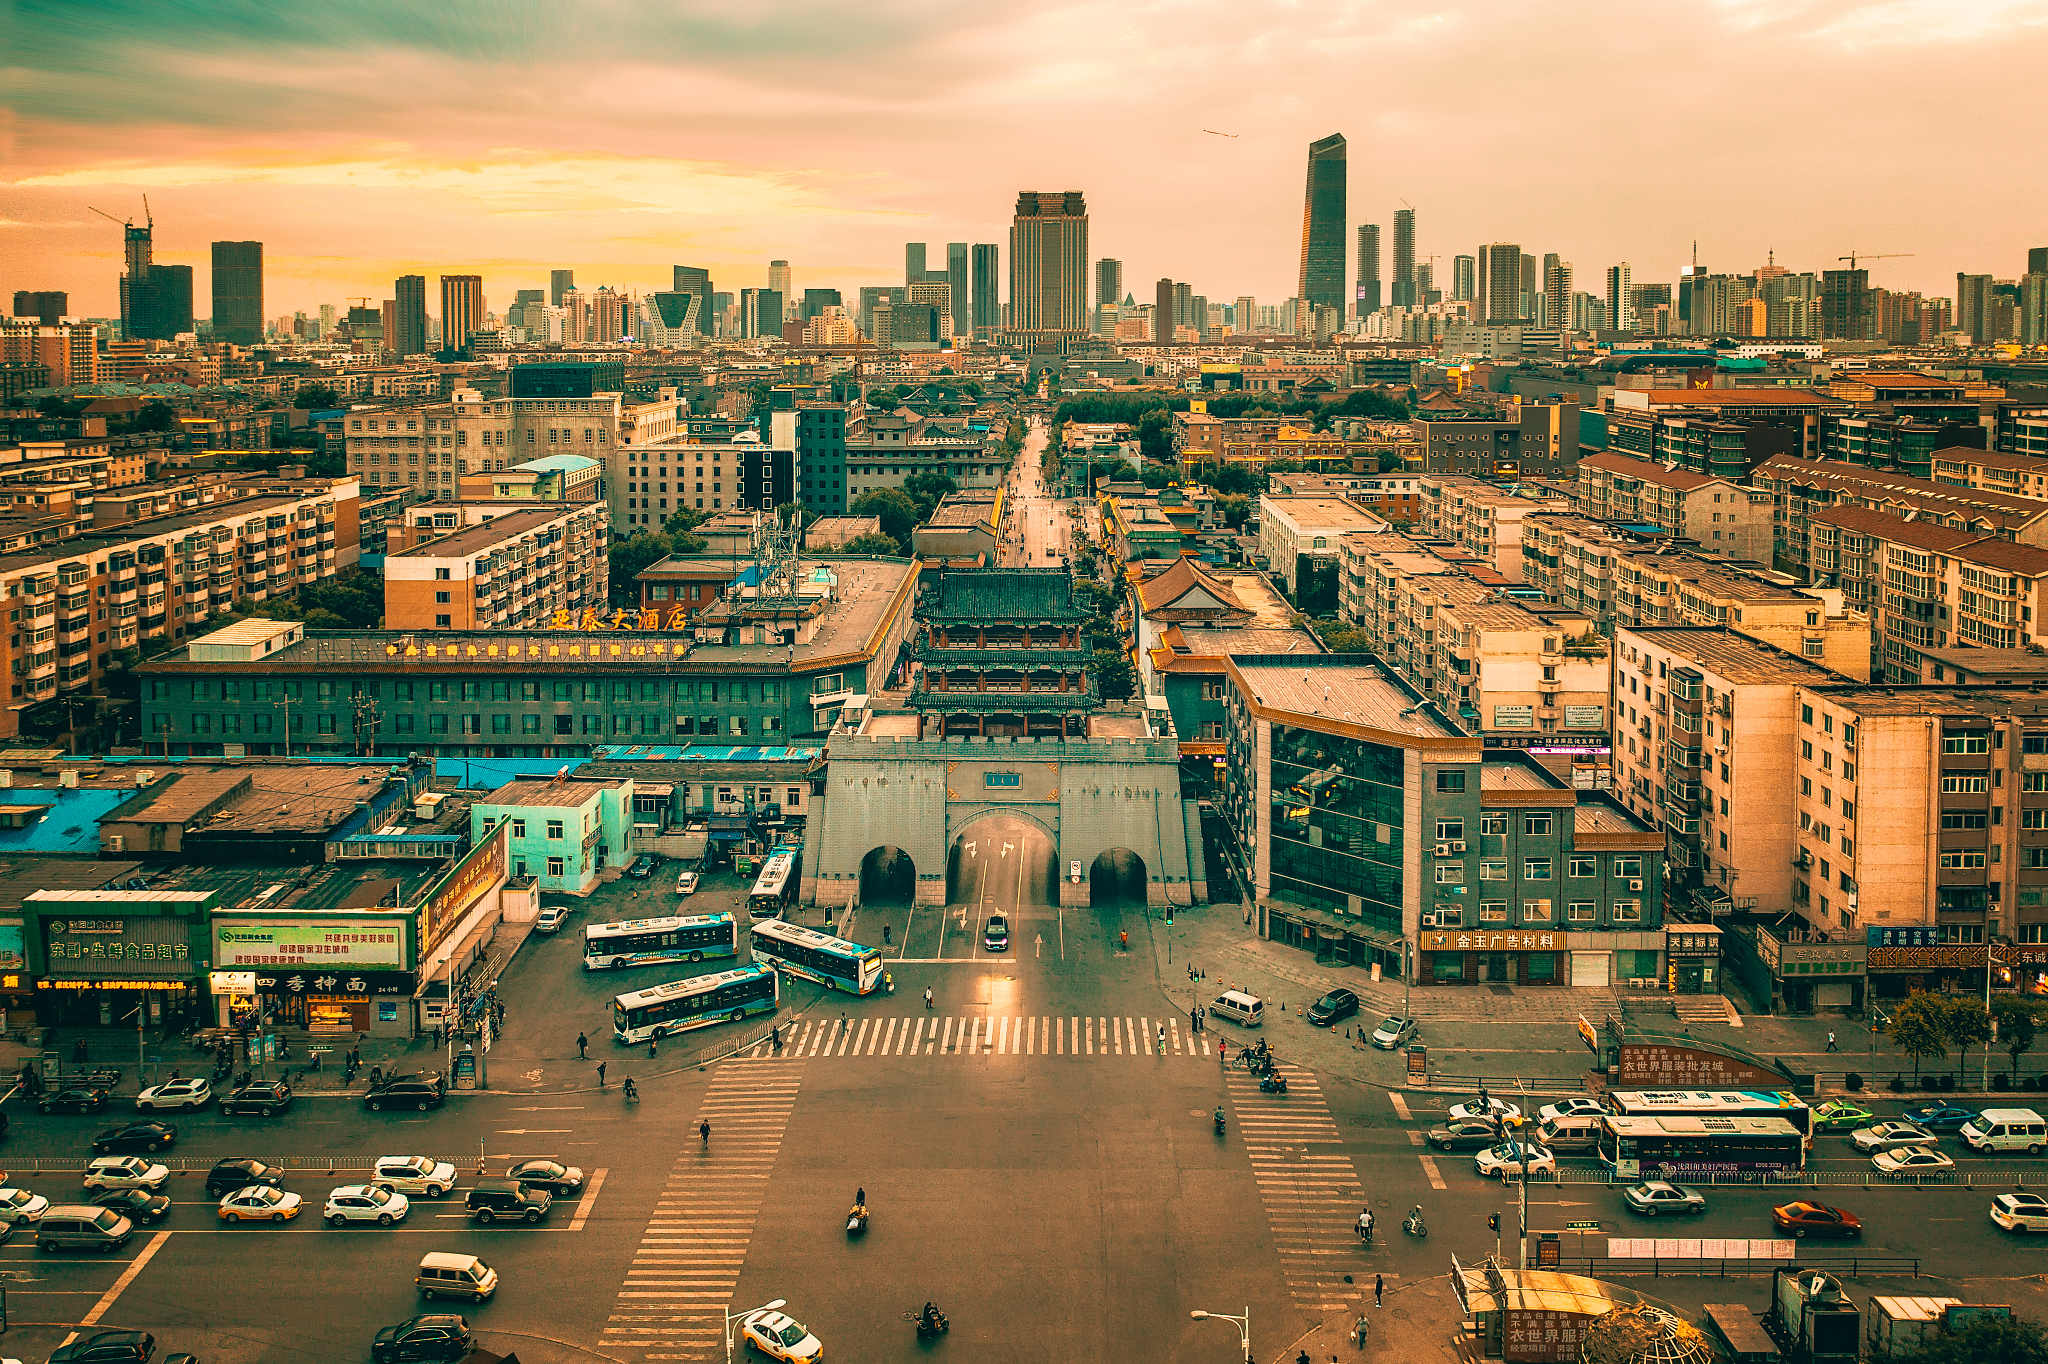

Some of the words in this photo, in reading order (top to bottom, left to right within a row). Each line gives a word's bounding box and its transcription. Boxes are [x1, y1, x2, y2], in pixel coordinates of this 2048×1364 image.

[548, 603, 687, 633] 亚泰大酒店
[1456, 934, 1554, 948] 金玉广告材料
[1788, 926, 1860, 943] 山水广告
[279, 945, 349, 953] 创建国家卫生城市
[1670, 938, 1719, 947] 天姿标识
[51, 942, 188, 959] 东副·生鲜食品超市
[2021, 951, 2047, 964] 东诚
[256, 975, 366, 992] 四季抻面
[1624, 1061, 1724, 1071] 衣世界服装批发城
[1510, 1312, 1569, 1320] 商品包退换
